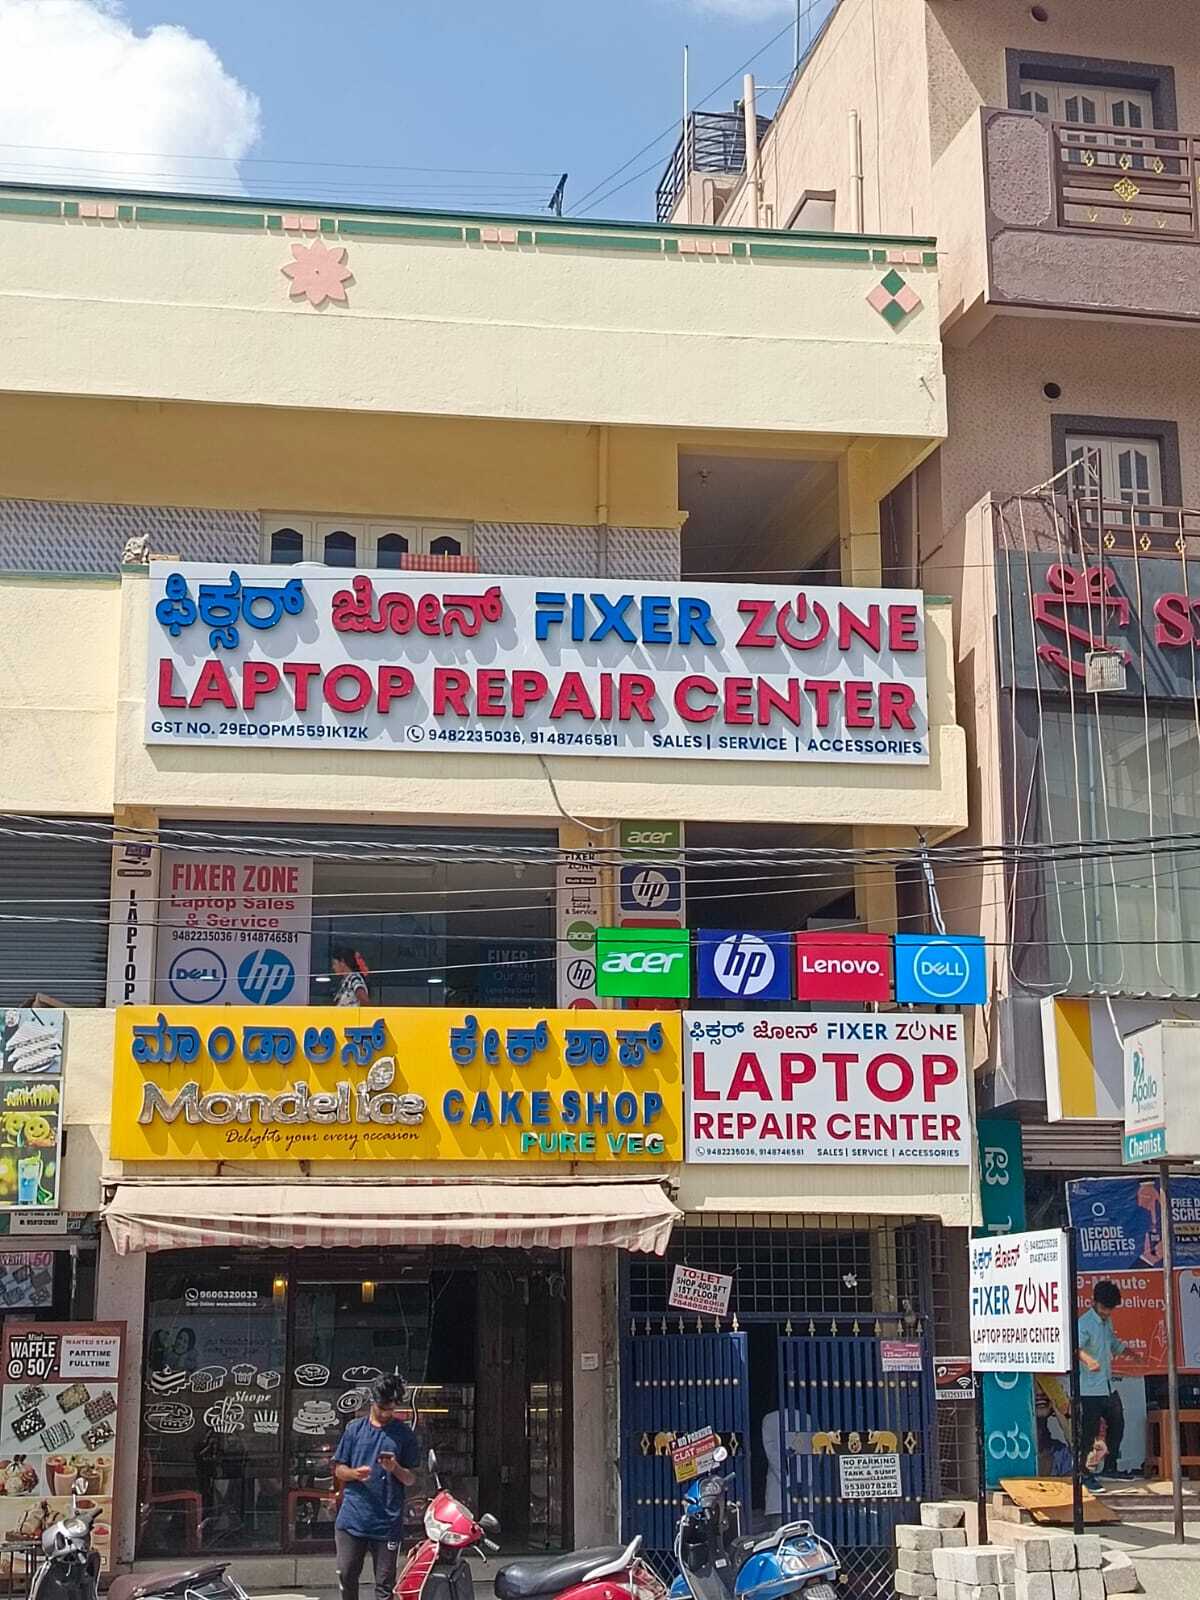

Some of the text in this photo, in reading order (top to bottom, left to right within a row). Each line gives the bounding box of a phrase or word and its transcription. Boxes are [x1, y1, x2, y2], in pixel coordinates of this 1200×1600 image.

[331, 575, 503, 638] ಜೋನ್
[534, 591, 919, 653] FIXER ZONE
[158, 657, 916, 730] LAPTOP REPAIR CENTER
[151, 721, 183, 734] GST
[186, 722, 215, 735] NO.
[530, 731, 619, 747] 9148746581
[652, 734, 923, 754] SALES SERVICE ACCESSORIES
[627, 831, 672, 844] acer
[171, 864, 298, 893] FIXER ZONE
[171, 894, 295, 911] Laptop Sales
[185, 914, 280, 929] & Service
[602, 951, 684, 974] acer
[802, 955, 881, 975] Lenovo
[921, 961, 964, 977] DELL
[176, 968, 220, 981] DELL
[826, 1020, 957, 1041] FIXER ZONE
[692, 1051, 959, 1103] LAPTOP
[1131, 1075, 1158, 1114] Apollo
[442, 1088, 665, 1127] CAKE SHOP
[693, 1112, 961, 1142] REPAIR CENTER
[225, 1128, 419, 1151] Delights your every occasion
[520, 1132, 665, 1154] PURE VEG
[1128, 1133, 1162, 1159] Chemist
[817, 1148, 960, 1158] SALES SERVICE ACCESSORIES
[677, 1277, 695, 1287] SHOP
[682, 1268, 722, 1284] TO-LET
[693, 1289, 718, 1300] FLOOR
[972, 1277, 1060, 1316] FIXER ZONE
[973, 1327, 1061, 1344] LAPTOP REPAIR CENTER
[11, 1341, 56, 1358] WAFFLE
[1008, 1352, 1025, 1363] SALES
[1030, 1351, 1055, 1364] SERVICE
[8, 1358, 59, 1379] @ 50/-
[857, 1457, 896, 1465] PARKING
